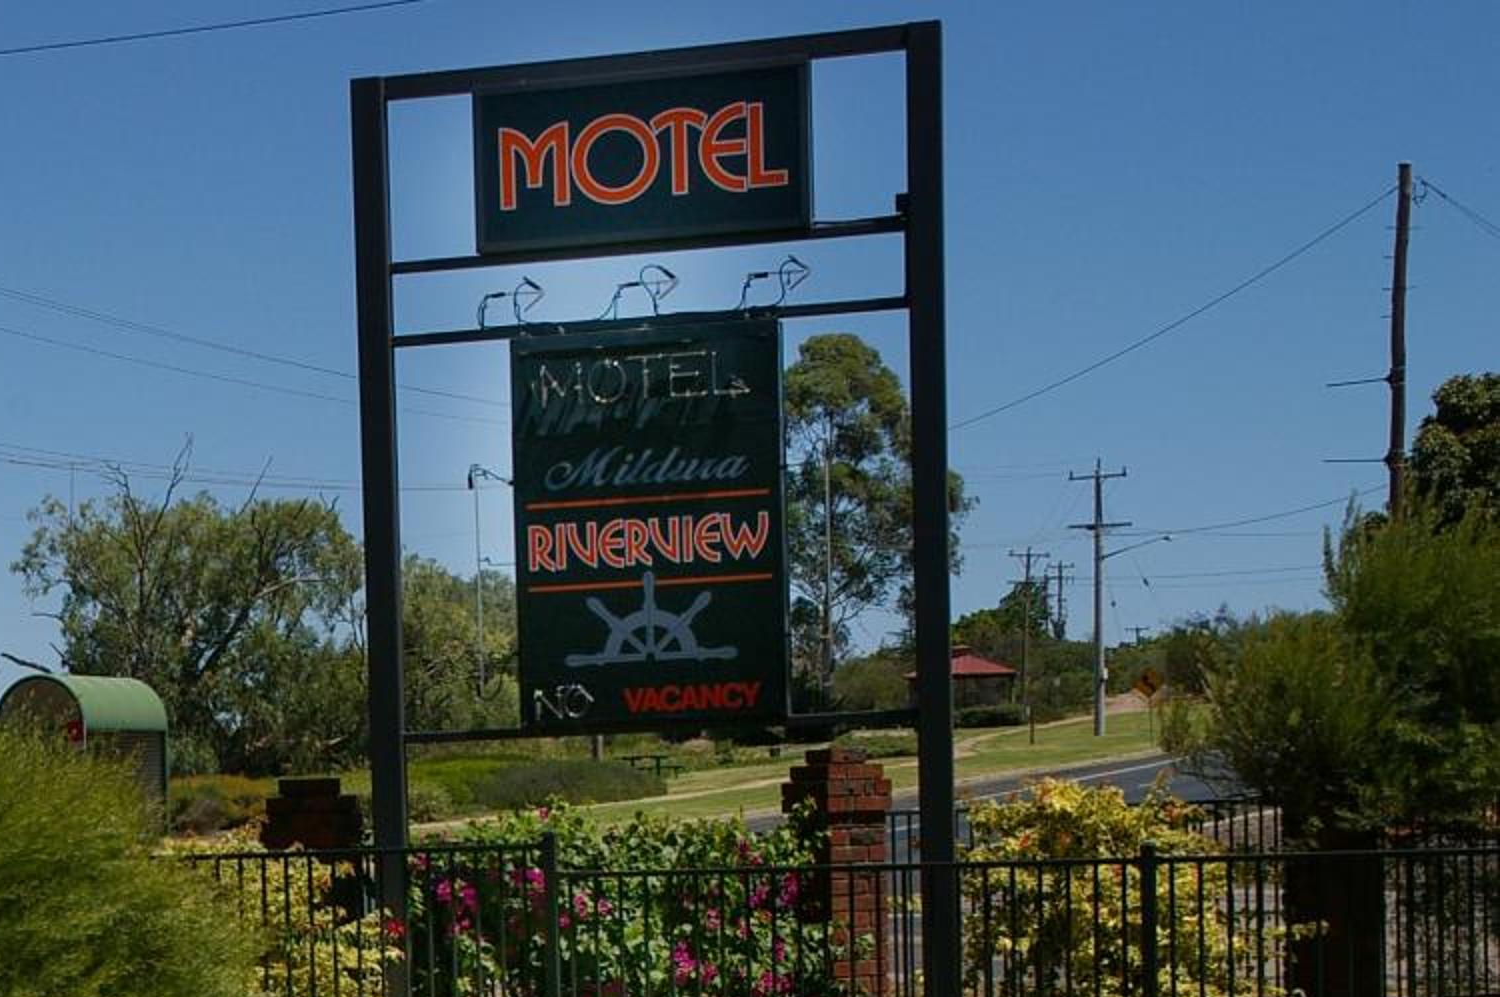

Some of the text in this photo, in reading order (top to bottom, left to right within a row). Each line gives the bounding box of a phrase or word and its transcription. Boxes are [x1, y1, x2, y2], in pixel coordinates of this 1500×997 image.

[499, 101, 789, 211] MOTEL
[531, 351, 751, 408] MOTEL
[544, 446, 749, 491] Mildura
[527, 511, 770, 573] RIVERVIEW
[533, 682, 761, 721] NO VACANCY
